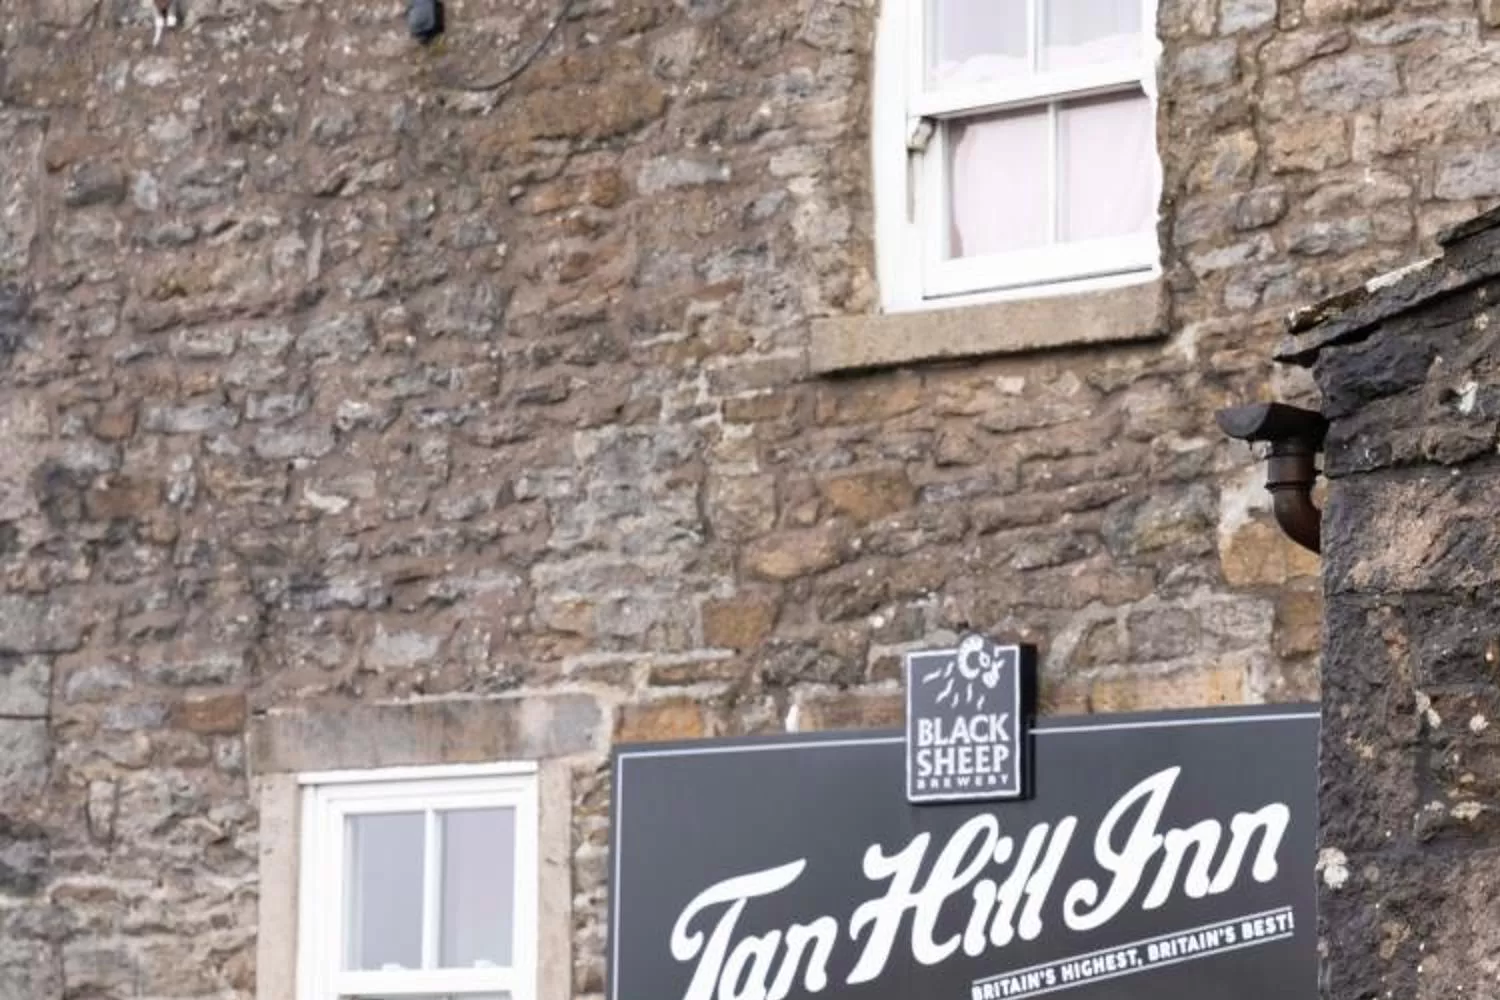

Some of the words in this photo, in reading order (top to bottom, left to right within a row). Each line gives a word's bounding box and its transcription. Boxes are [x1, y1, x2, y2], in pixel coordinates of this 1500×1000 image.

[916, 711, 1010, 748] BLACK
[915, 743, 1010, 778] SHEEP
[916, 773, 1009, 790] BREWERY
[846, 813, 1078, 985] Hill
[1063, 765, 1290, 931] Inn
[1061, 948, 1143, 983] HIGHEST,
[1147, 925, 1236, 962] BRITAIN'S
[1241, 911, 1295, 940] BEST!
